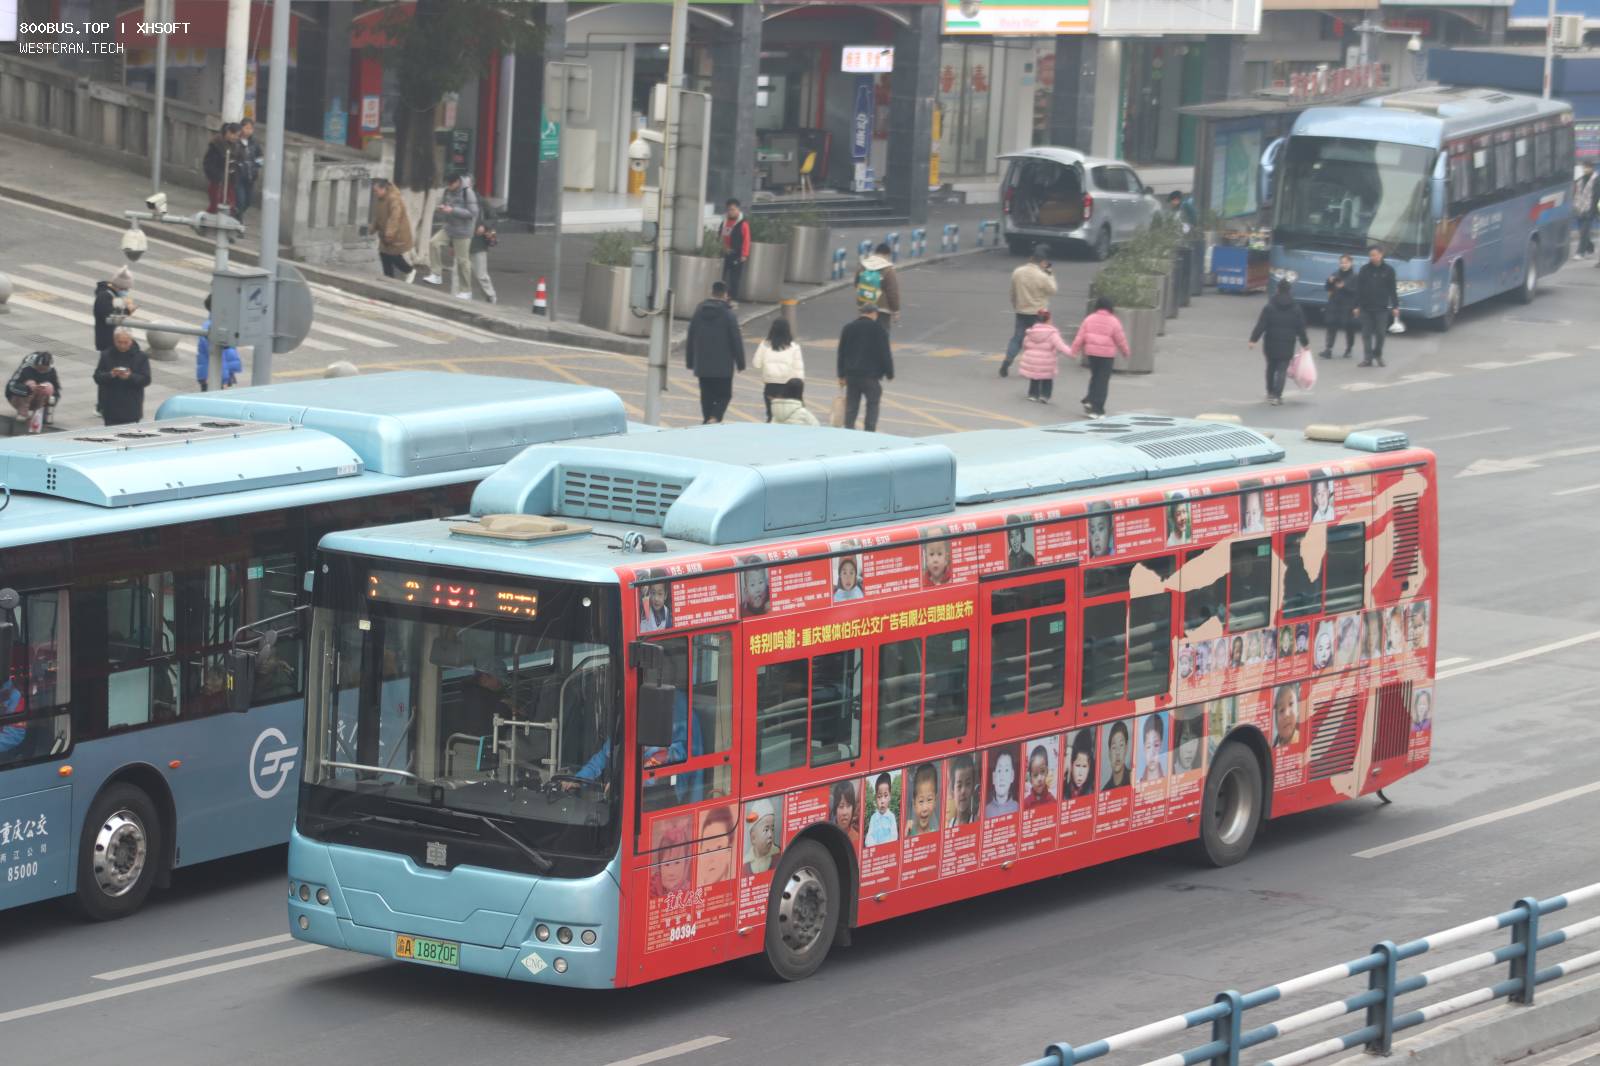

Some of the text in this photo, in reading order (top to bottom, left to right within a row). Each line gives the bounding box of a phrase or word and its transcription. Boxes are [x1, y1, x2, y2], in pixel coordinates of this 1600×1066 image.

[0, 813, 49, 845] 重庆公交
[7, 861, 38, 882] 85000
[669, 922, 697, 942] 80394
[525, 957, 544, 969] CNG
